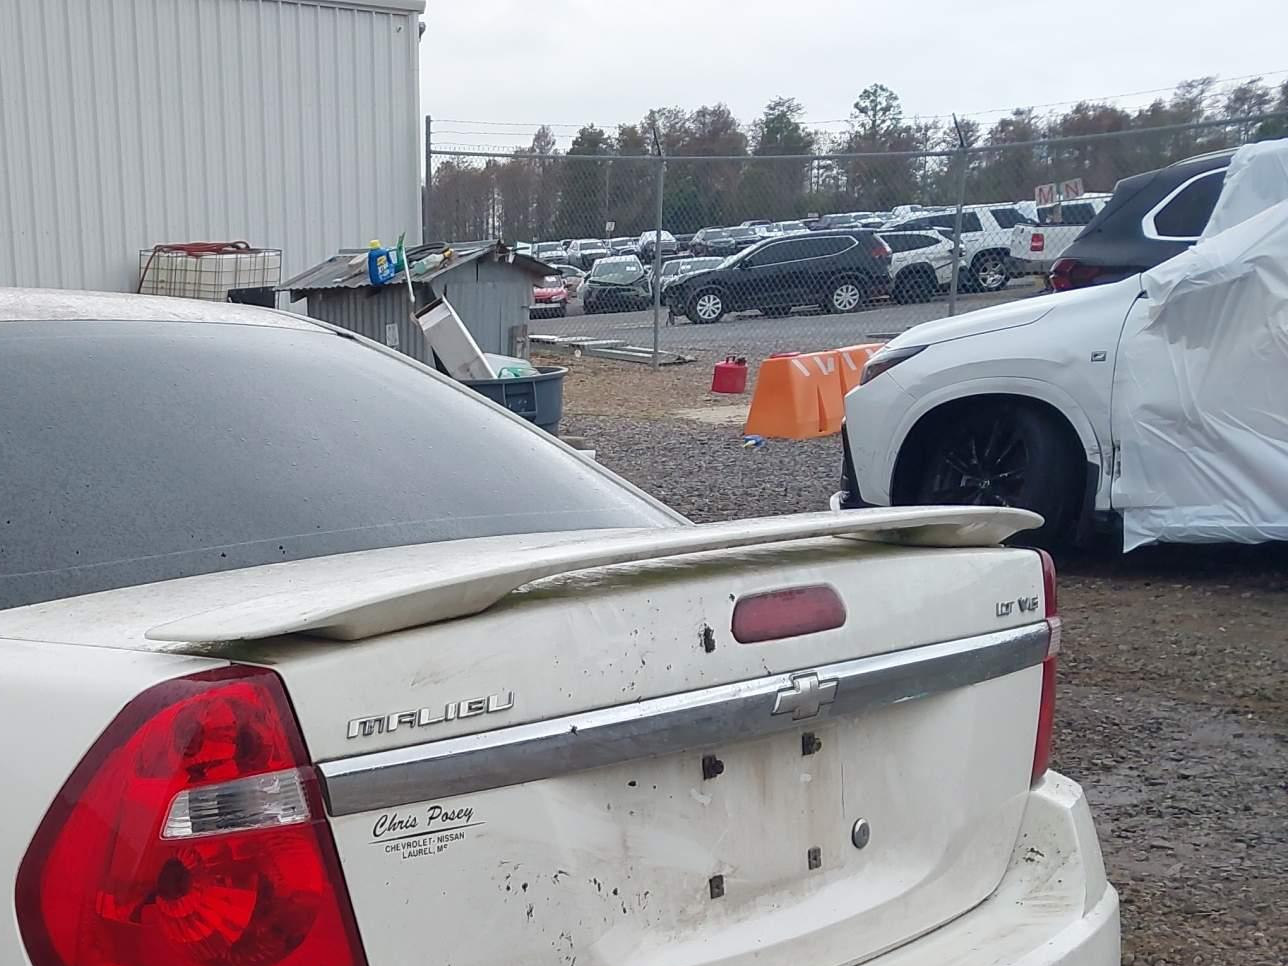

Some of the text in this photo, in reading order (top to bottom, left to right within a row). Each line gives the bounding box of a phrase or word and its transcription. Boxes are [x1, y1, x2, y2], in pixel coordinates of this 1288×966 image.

[1038, 181, 1080, 204] M N
[347, 691, 514, 739] MALIBU
[373, 805, 474, 837] Chris Posey
